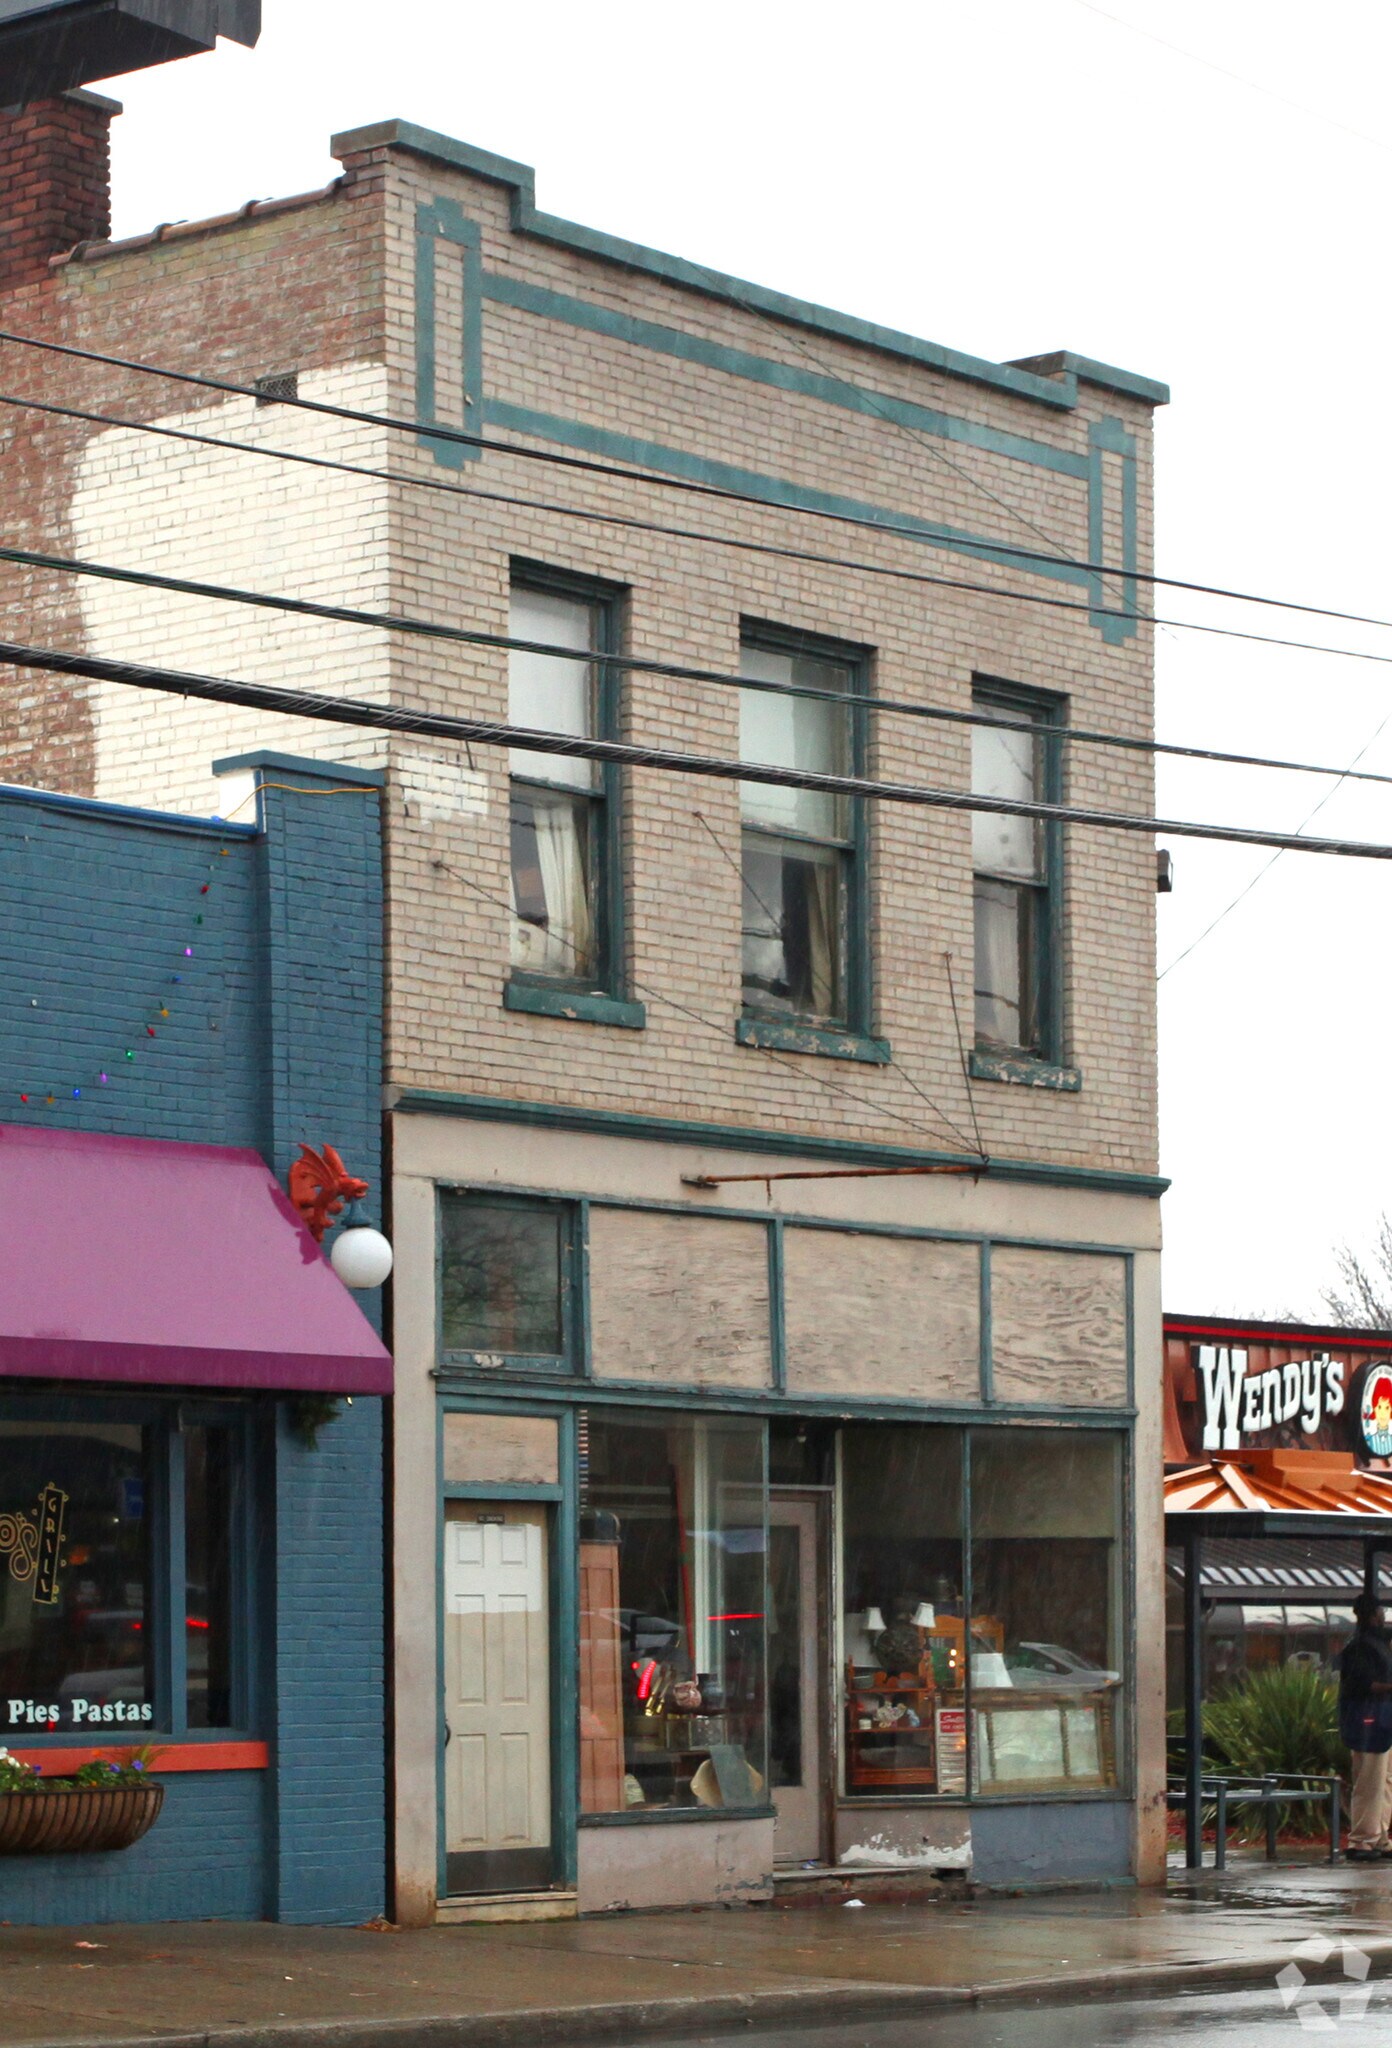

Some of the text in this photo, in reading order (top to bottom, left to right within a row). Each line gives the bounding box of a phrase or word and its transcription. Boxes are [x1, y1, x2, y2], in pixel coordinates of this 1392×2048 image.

[41, 1497, 57, 1593] GRILL
[7, 1699, 153, 1724] Pies Pastas
